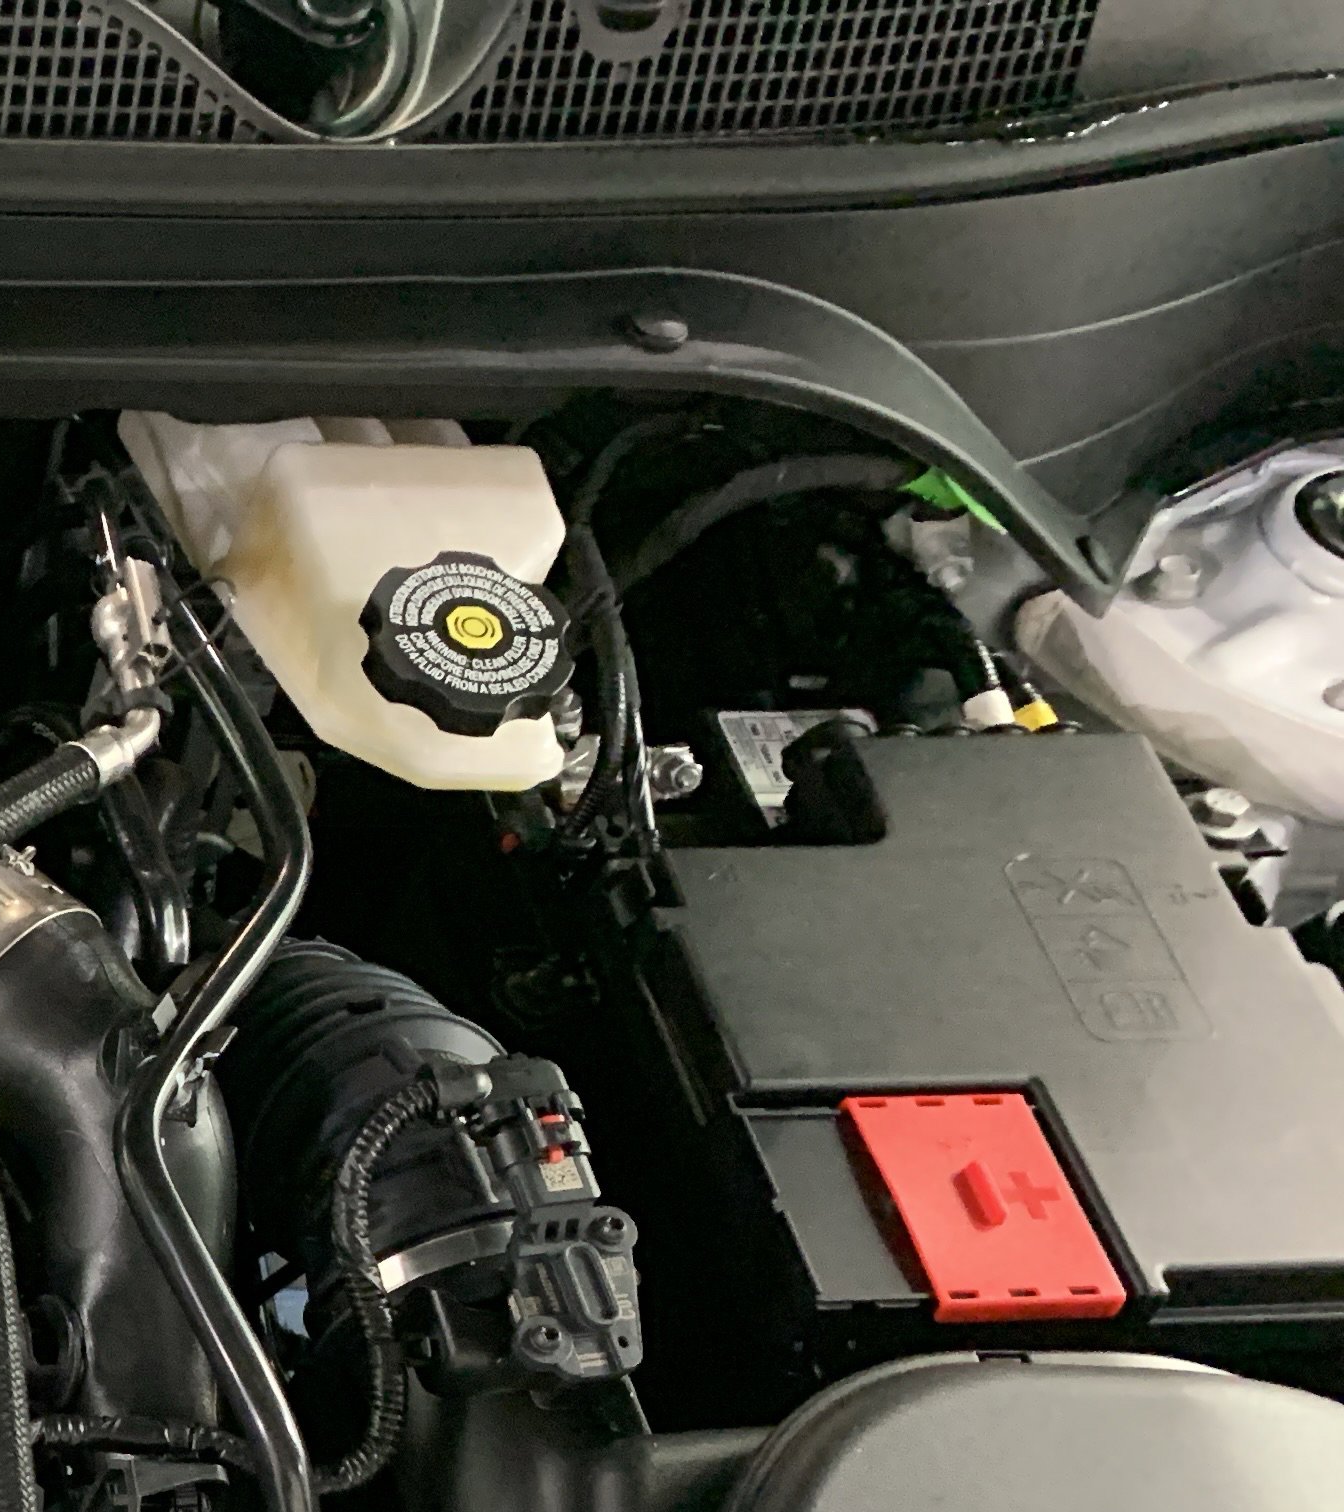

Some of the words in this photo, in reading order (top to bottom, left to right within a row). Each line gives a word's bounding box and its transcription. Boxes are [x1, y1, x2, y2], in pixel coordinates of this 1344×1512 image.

[410, 632, 430, 650] CAP
[423, 649, 464, 678] BEFORE
[413, 656, 445, 680] FLUID
[444, 675, 478, 693] FROM
[480, 683, 489, 694] A
[488, 677, 530, 695] SEALED
